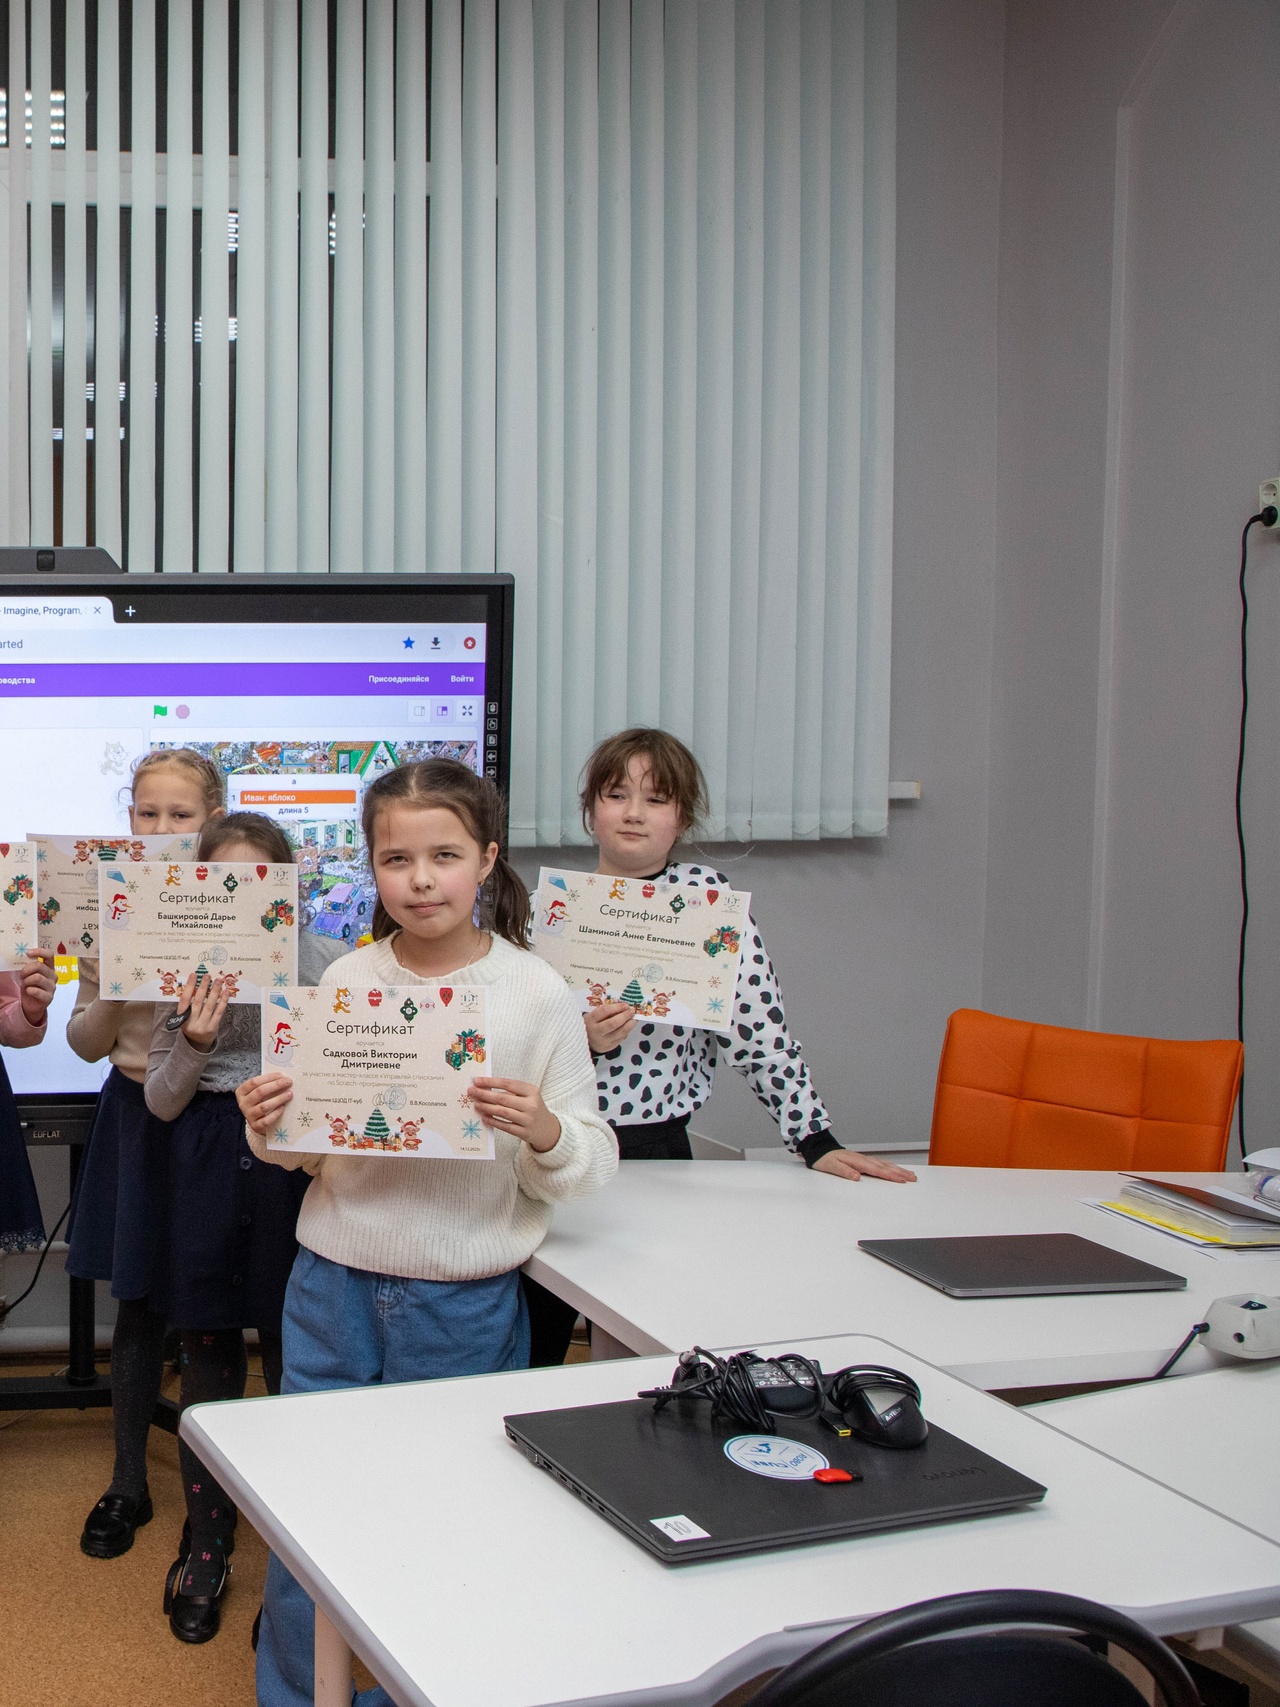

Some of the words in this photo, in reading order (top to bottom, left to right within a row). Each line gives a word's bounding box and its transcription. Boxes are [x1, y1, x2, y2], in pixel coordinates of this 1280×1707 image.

[3, 606, 41, 616] Imagine,
[368, 674, 430, 684] Присоединяйся
[450, 674, 475, 683] Войти
[243, 794, 267, 802] Иван:
[268, 794, 297, 802] яблоко
[278, 807, 302, 815] длина
[304, 806, 309, 814] 5
[159, 891, 235, 905] Сертификат
[157, 912, 209, 921] Башкировой
[210, 913, 236, 922] Дарье
[600, 904, 680, 924] Сертификат
[171, 921, 223, 929] Михайловне
[579, 925, 620, 937] Шаминой
[622, 931, 645, 940] Анне
[647, 934, 695, 947] Евгеньевне
[326, 1020, 415, 1037] Сертификат
[323, 1048, 368, 1058] Садковой
[370, 1050, 418, 1060] Виктории
[341, 1060, 401, 1070] Дмитриевне
